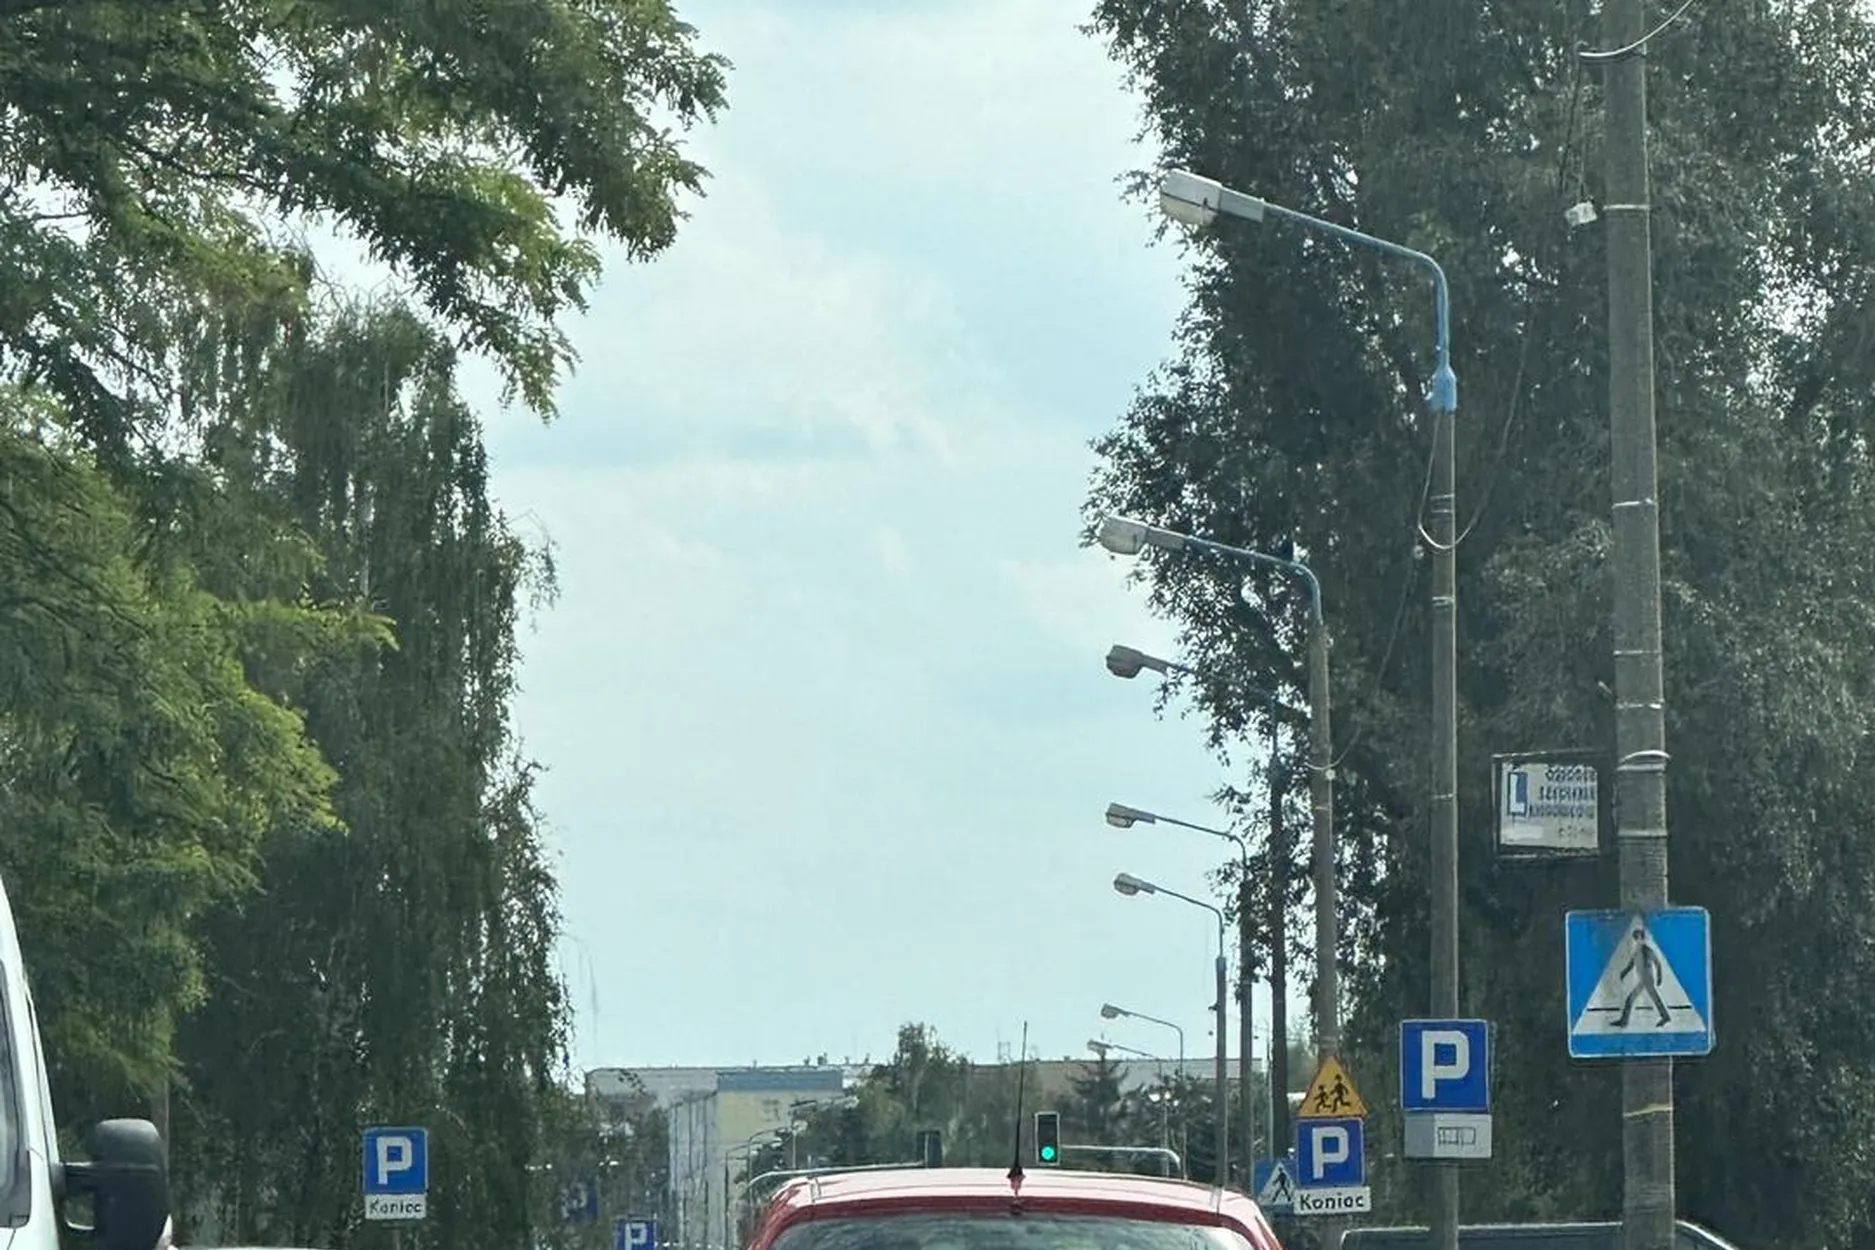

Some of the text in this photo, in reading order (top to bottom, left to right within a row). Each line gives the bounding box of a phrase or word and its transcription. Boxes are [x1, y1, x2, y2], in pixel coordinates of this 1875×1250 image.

[1421, 1030, 1470, 1100] P
[376, 1135, 412, 1186] P
[1311, 1126, 1349, 1180] P
